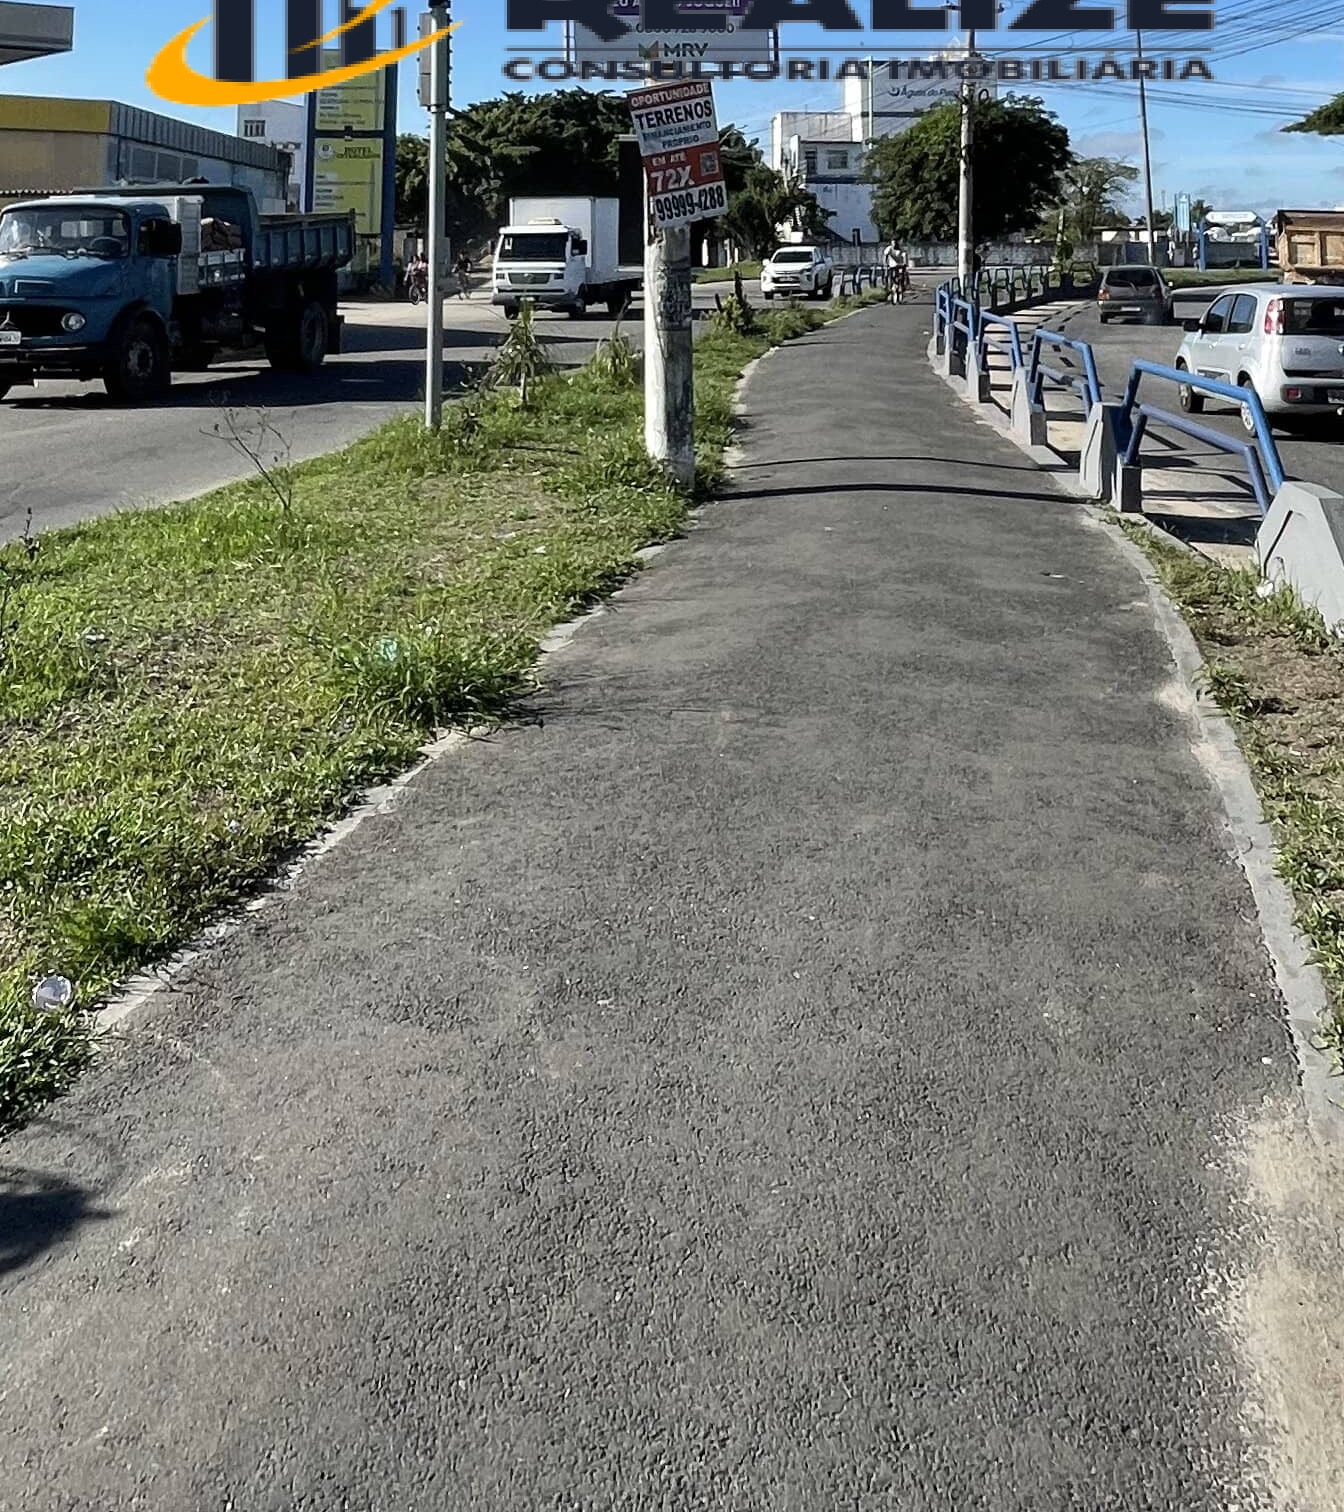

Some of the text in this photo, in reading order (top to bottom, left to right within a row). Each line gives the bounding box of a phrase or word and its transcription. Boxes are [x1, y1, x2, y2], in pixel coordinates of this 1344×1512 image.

[663, 42, 709, 58] MRV
[630, 82, 710, 108] OPORTUNIDADE
[635, 99, 713, 130] TERRENOS
